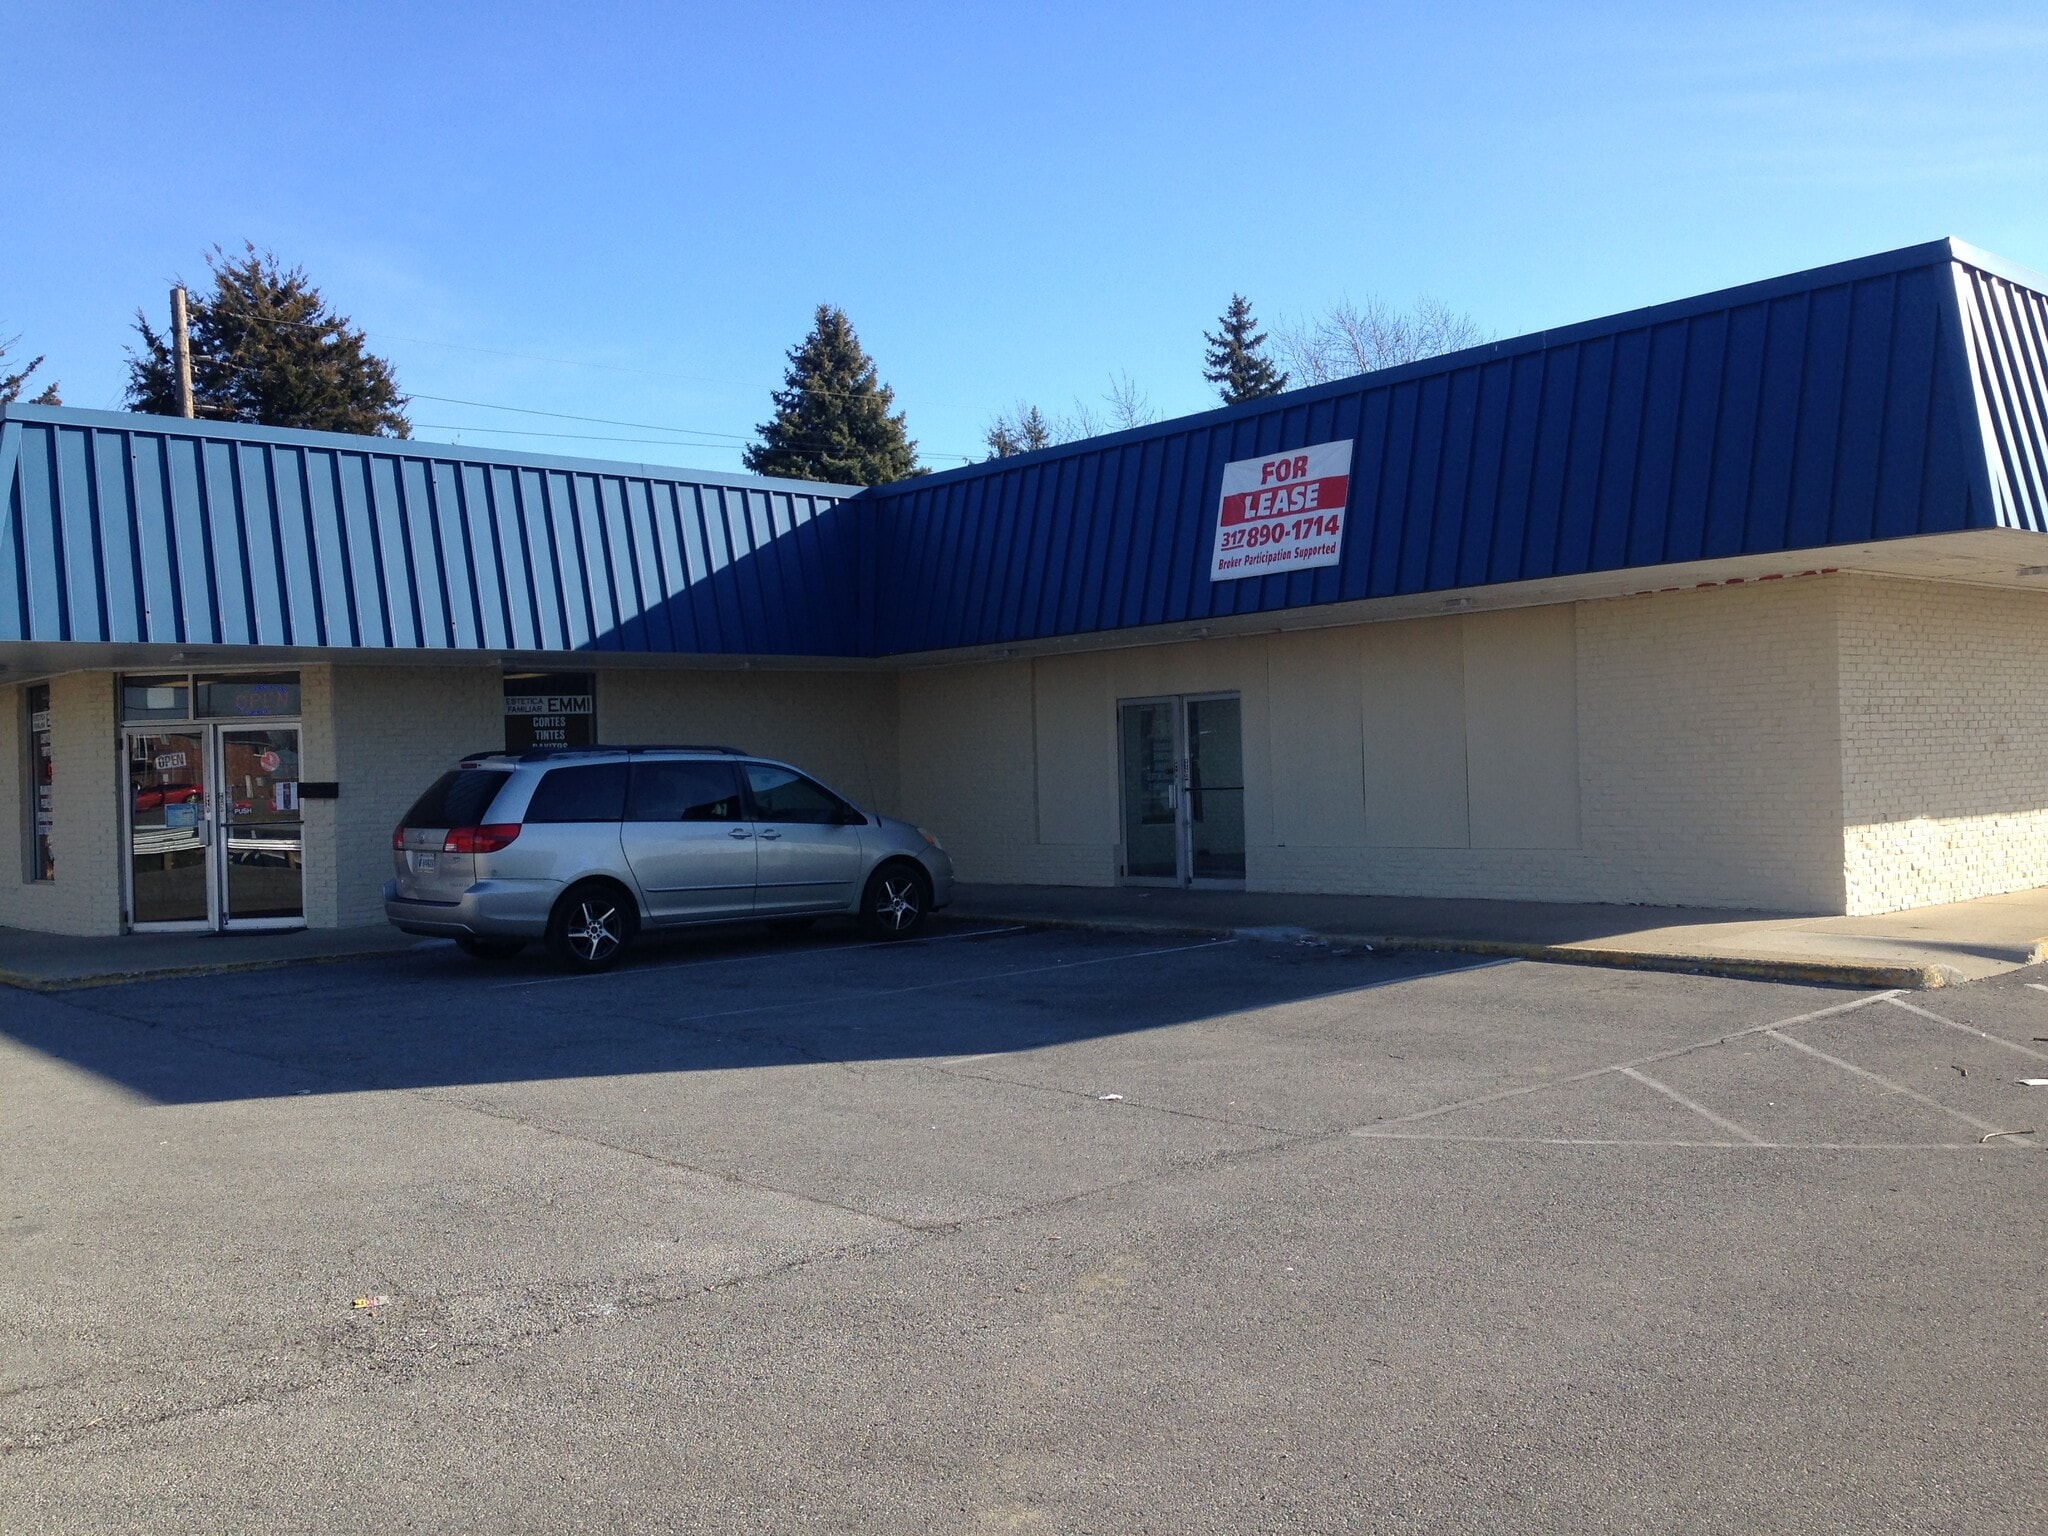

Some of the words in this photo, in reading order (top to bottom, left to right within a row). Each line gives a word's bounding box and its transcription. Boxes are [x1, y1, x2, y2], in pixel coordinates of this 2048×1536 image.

[1261, 455, 1308, 485] FOR
[1244, 483, 1320, 519] LEASE
[1247, 514, 1339, 548] 890-1714
[1218, 556, 1242, 570] Broker
[1244, 549, 1292, 566] Participation
[1294, 542, 1337, 561] Supported
[507, 705, 543, 713] FAMILIAR
[548, 697, 590, 712] EMMI
[533, 716, 566, 727] CORTES
[534, 729, 566, 740] TINTES
[158, 753, 185, 768] OPEN
